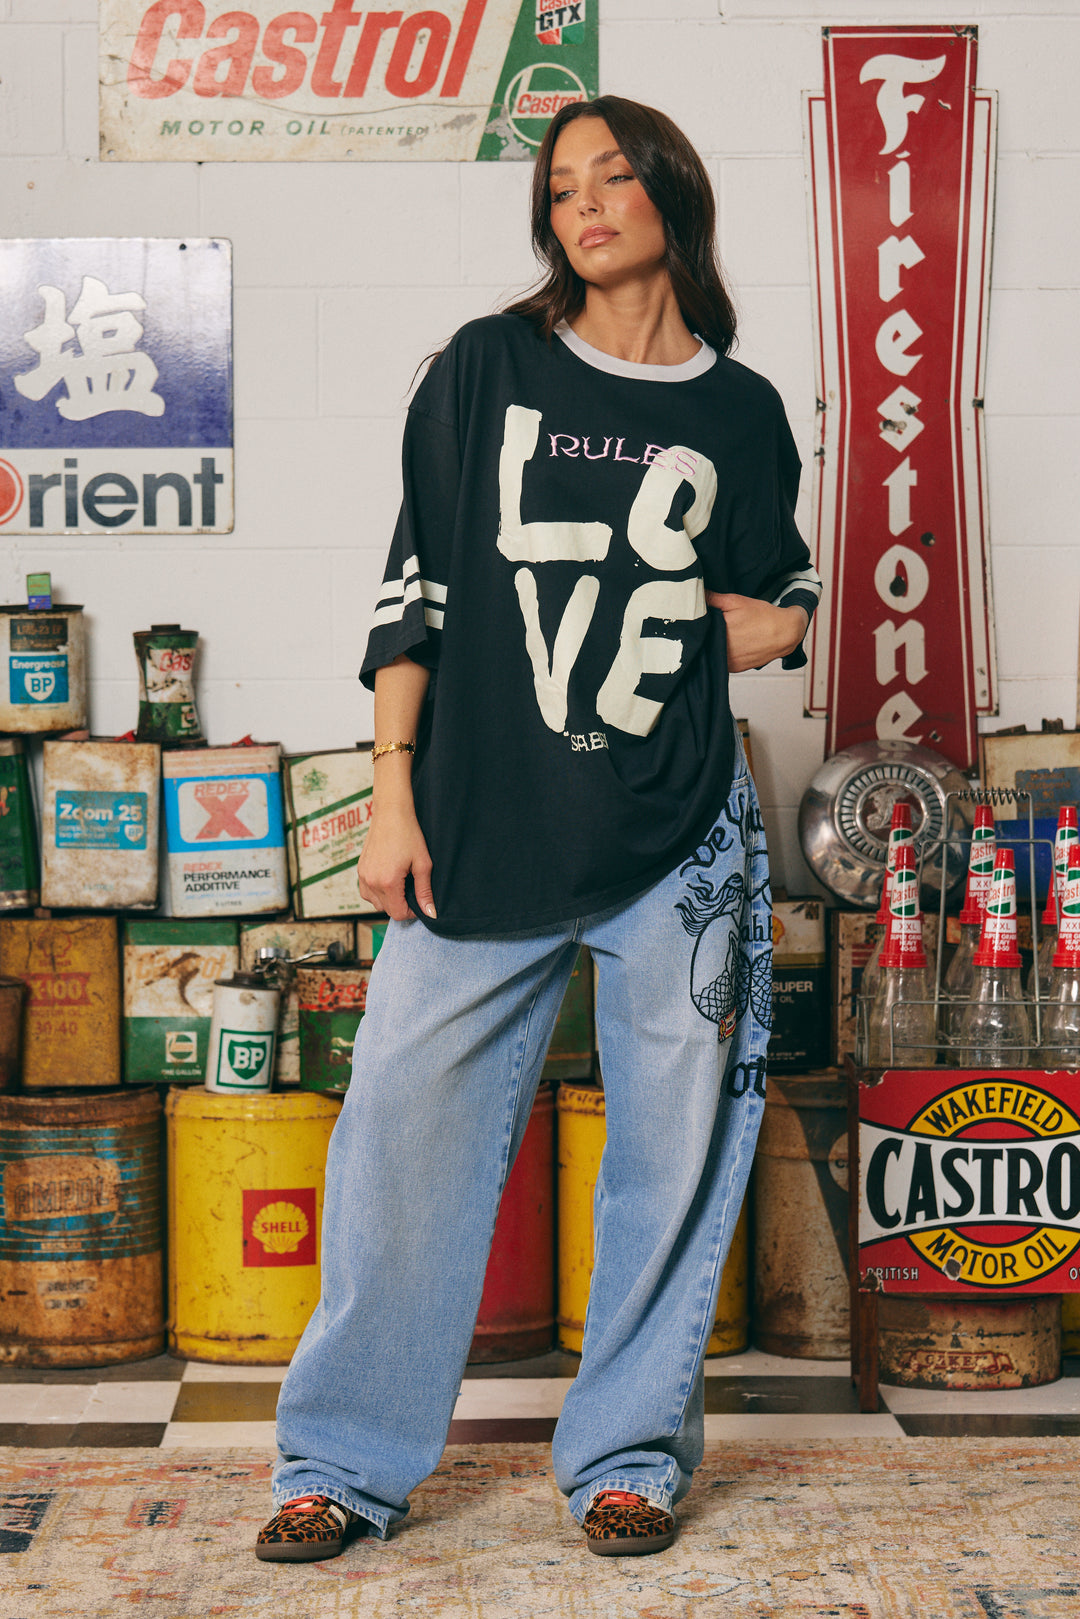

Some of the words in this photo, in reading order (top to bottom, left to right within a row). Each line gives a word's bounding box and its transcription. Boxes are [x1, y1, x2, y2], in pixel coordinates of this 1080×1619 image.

[540, 3, 581, 31] GTX
[127, 0, 487, 98] Castrol
[160, 120, 265, 136] MOTOR
[286, 120, 331, 136] OIL
[14, 275, 165, 420] 塩
[859, 54, 946, 744] Firestone
[548, 433, 698, 477] RULES
[12, 659, 66, 671] Energrease
[31, 677, 52, 692] BP
[194, 781, 251, 798] REDEX
[60, 803, 113, 820] Zoom
[119, 804, 142, 821] 25
[301, 806, 363, 848] CASTROL
[182, 861, 223, 872] REDEX
[183, 868, 271, 882] PERFORMANCE
[185, 880, 240, 892] ADDITIVE
[992, 923, 1011, 932] XXL
[31, 980, 82, 1001] X-100
[771, 980, 813, 993] SUPER
[232, 1046, 265, 1070] BP
[924, 1086, 1063, 1134] WAKEFIELD
[866, 1136, 1080, 1229] CASTRO
[14, 1175, 110, 1215] AMPOL
[261, 1221, 301, 1233] SHELL
[926, 1231, 1019, 1280] MOTOR
[1025, 1232, 1067, 1269] OIL
